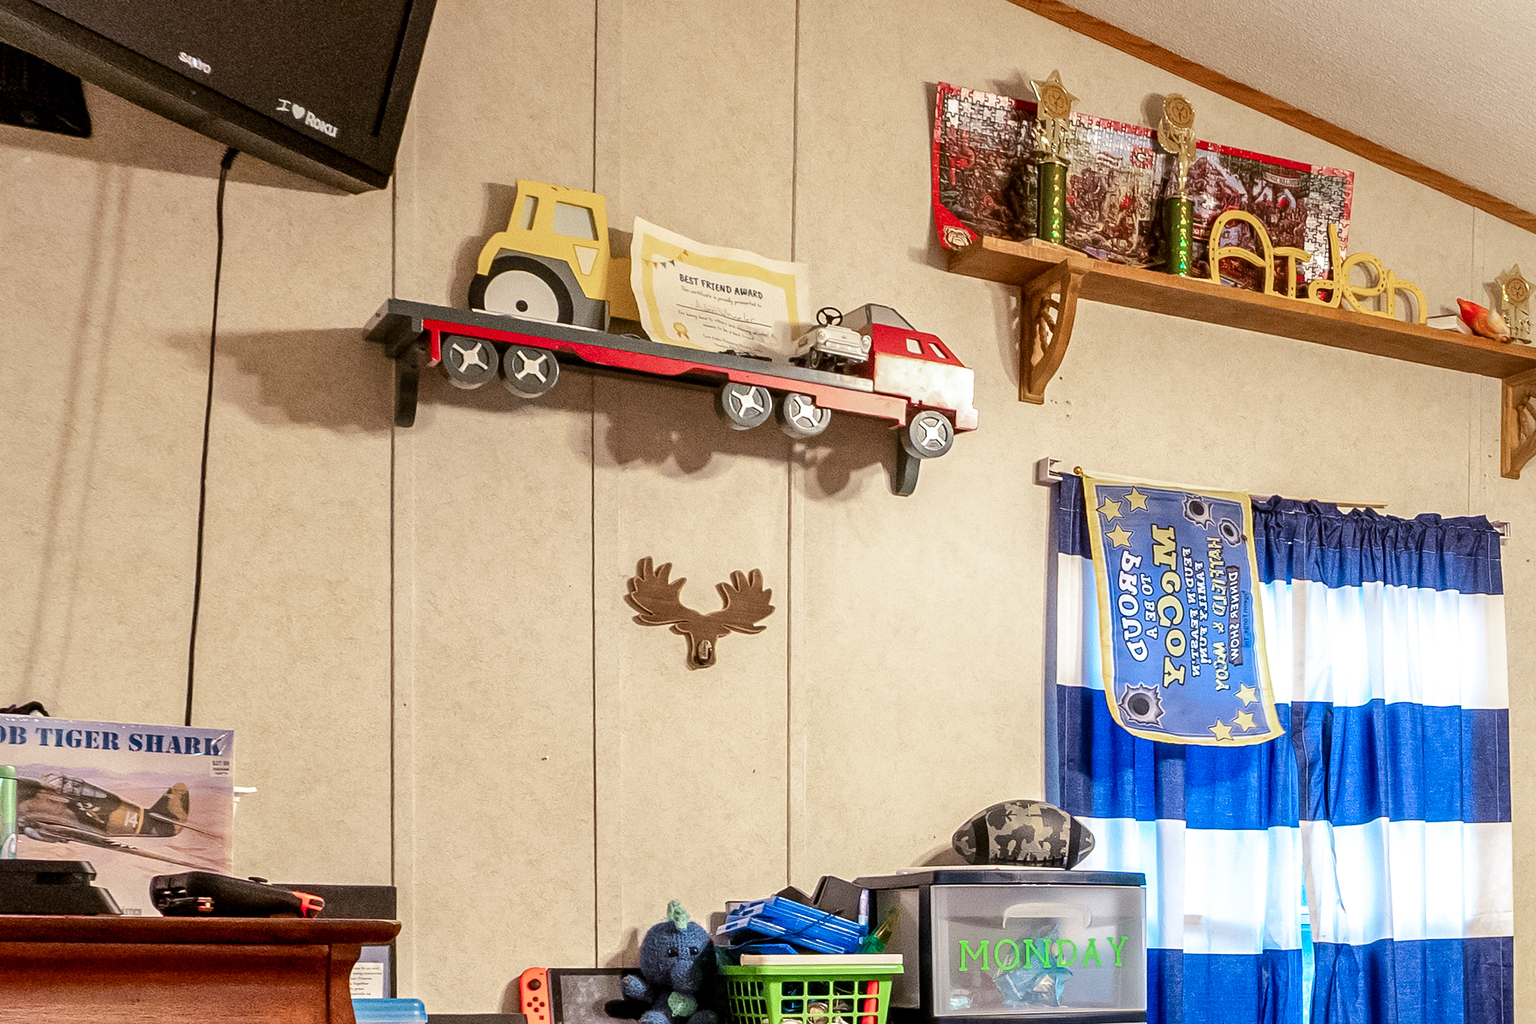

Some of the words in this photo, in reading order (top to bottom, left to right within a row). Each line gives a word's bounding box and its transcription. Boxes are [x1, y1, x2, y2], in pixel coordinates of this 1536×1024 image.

[679, 273, 699, 286] BEST
[701, 279, 732, 294] FRIEND
[734, 287, 764, 300] AWARD
[35, 727, 121, 751] TIGER
[128, 732, 224, 756] SHARK
[957, 935, 1129, 972] MONDAY
